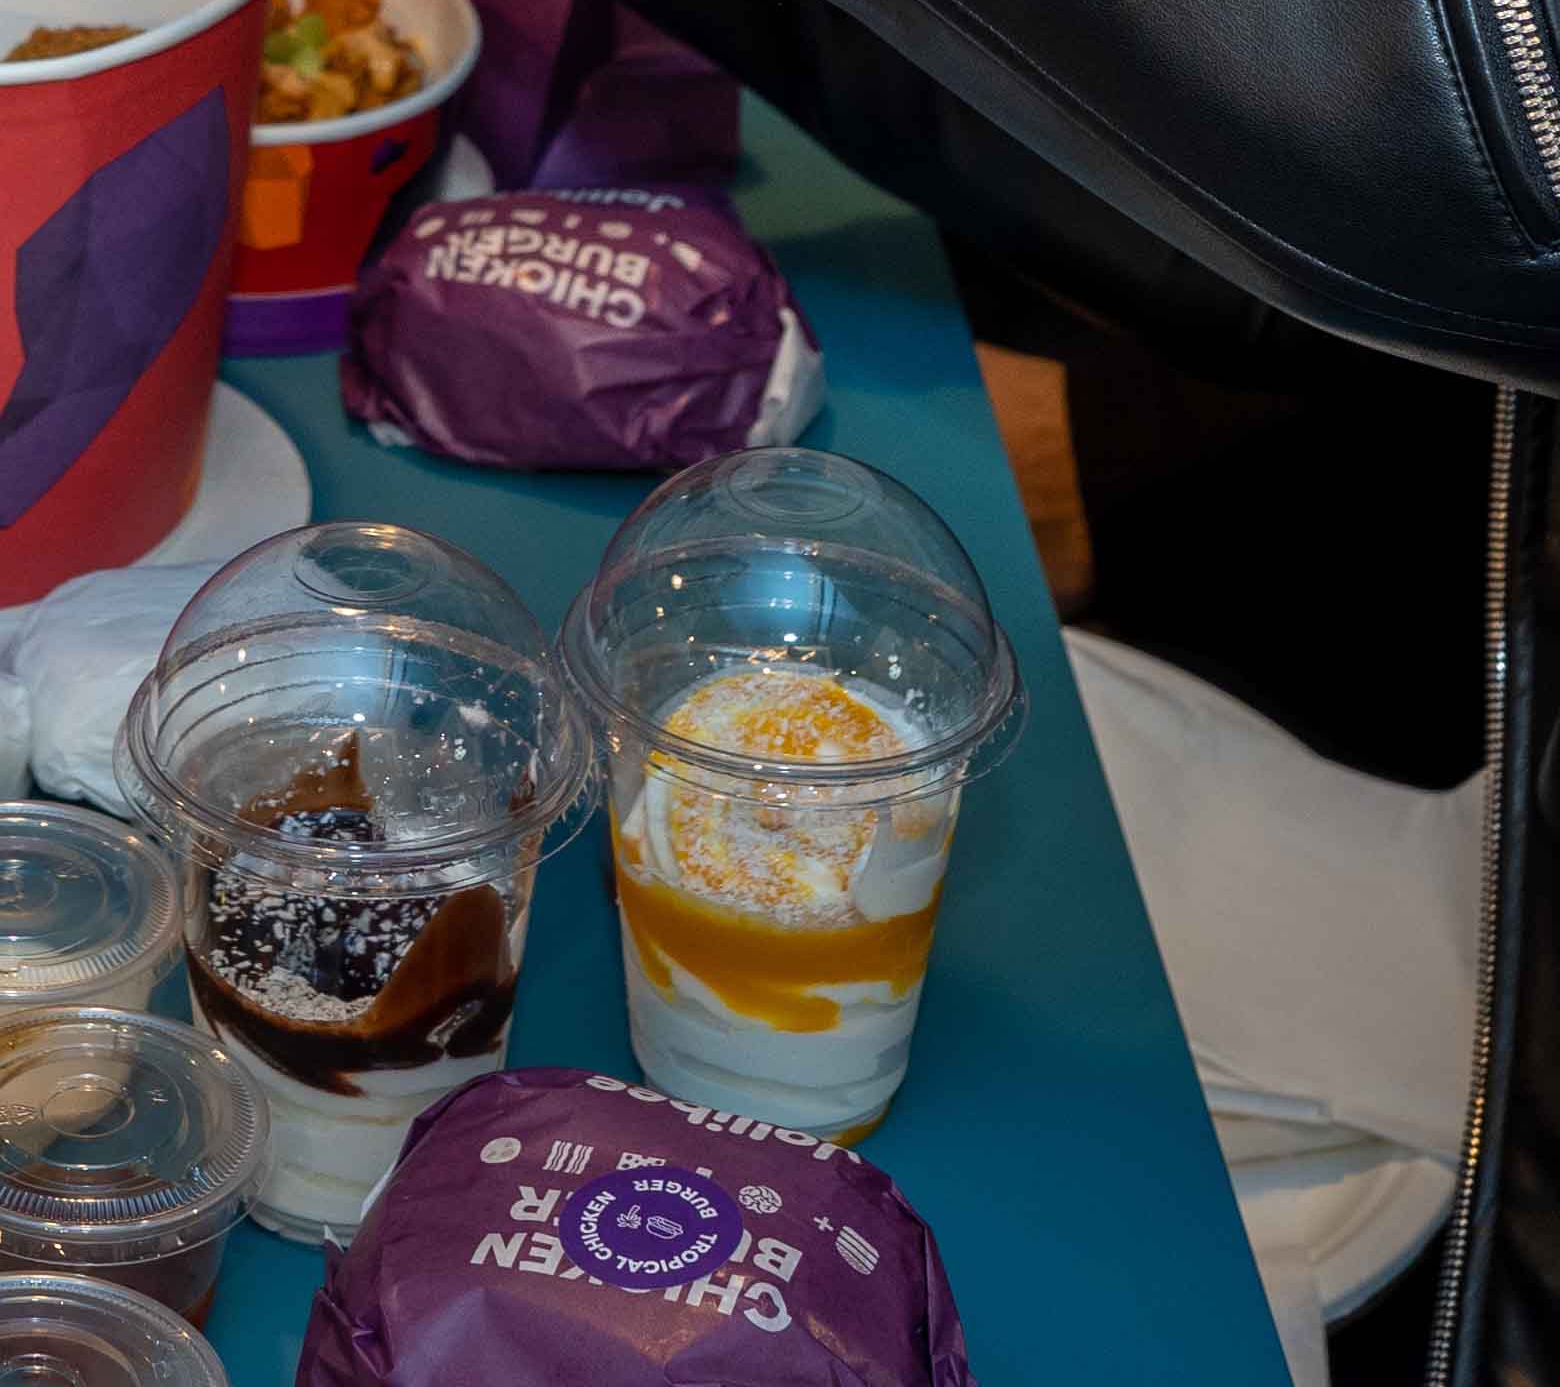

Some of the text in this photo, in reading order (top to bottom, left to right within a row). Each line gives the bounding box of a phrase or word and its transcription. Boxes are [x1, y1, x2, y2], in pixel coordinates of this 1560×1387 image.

[425, 243, 646, 328] CHICKEN
[579, 1190, 617, 1262] CHICKEN
[632, 1178, 720, 1220] BURGER
[615, 1232, 719, 1275] TROPICAL
